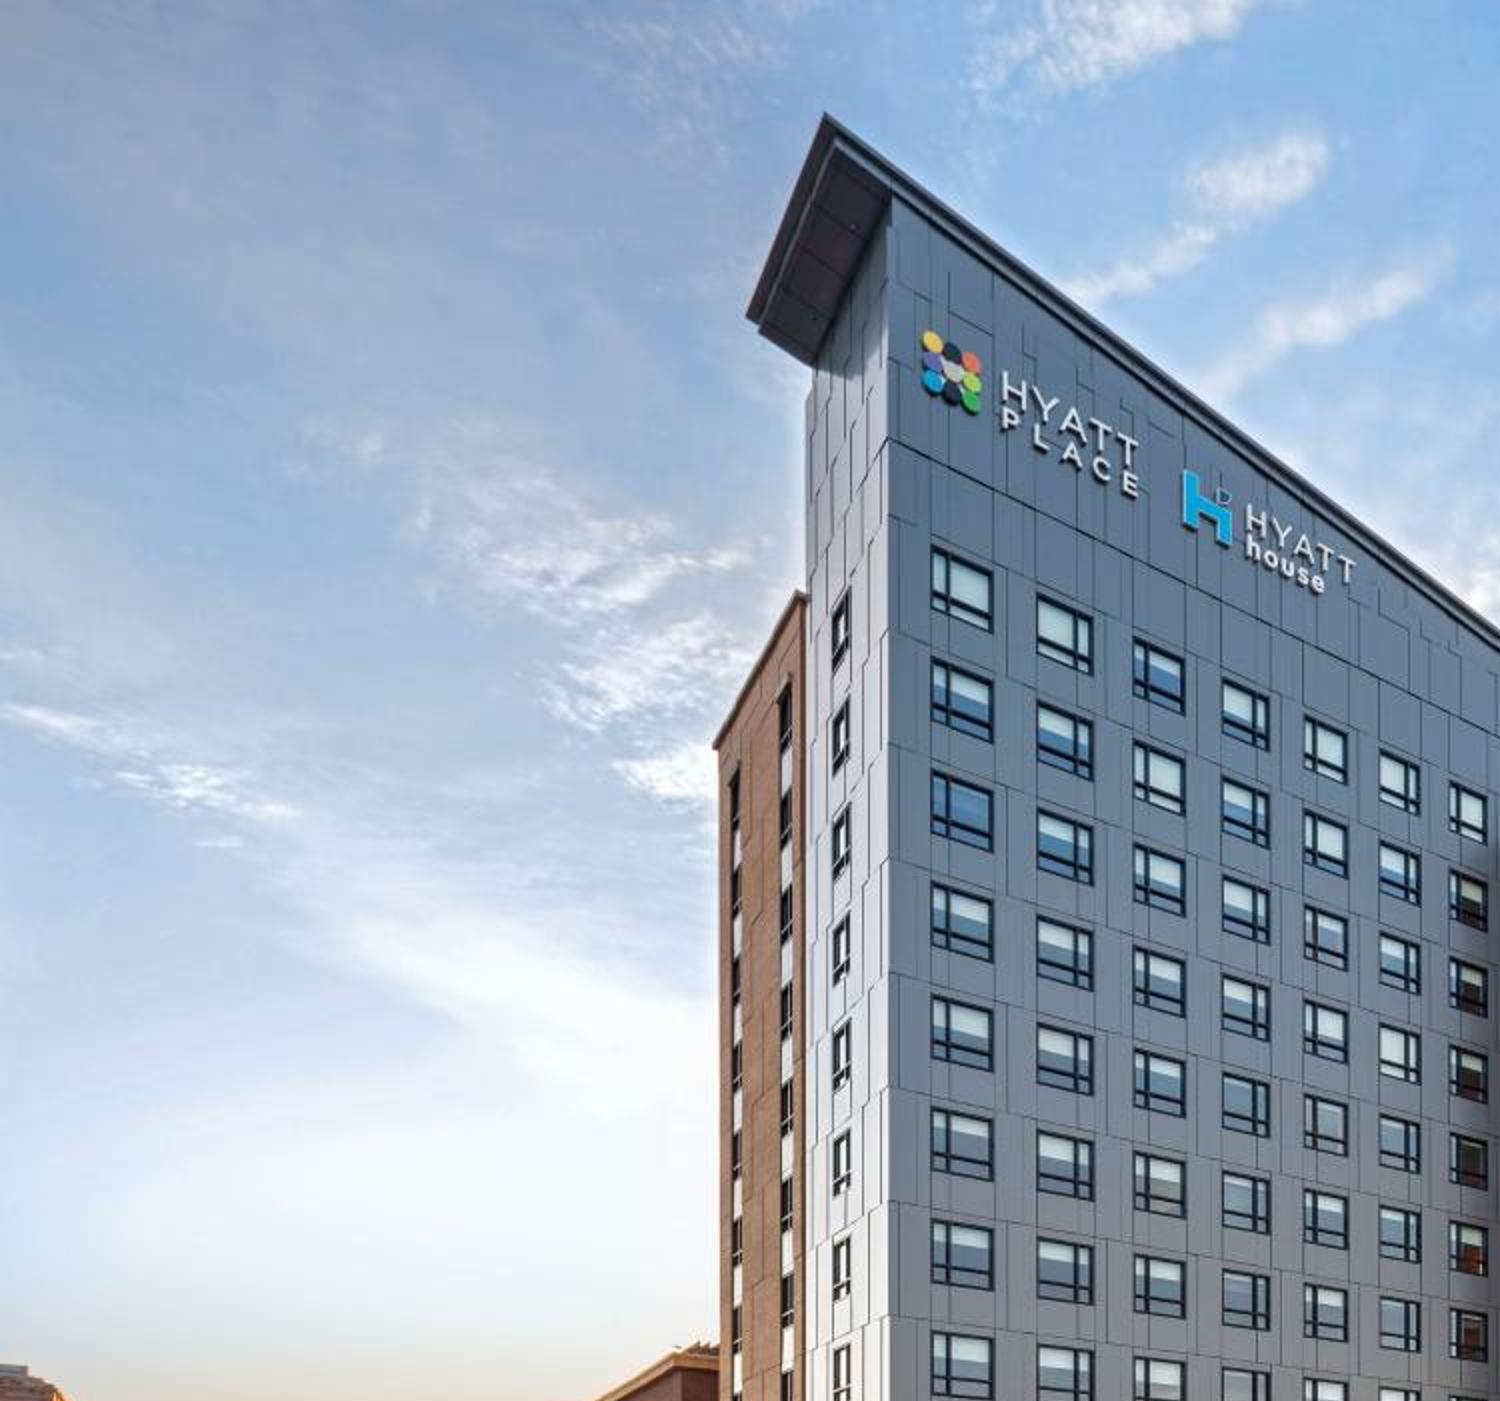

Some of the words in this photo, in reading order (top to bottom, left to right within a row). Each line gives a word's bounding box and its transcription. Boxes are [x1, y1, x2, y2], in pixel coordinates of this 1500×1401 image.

[1001, 370, 1139, 468] HYATT
[1001, 407, 1139, 498] PLACE
[1246, 503, 1356, 584] HYATT
[1246, 533, 1325, 593] house
